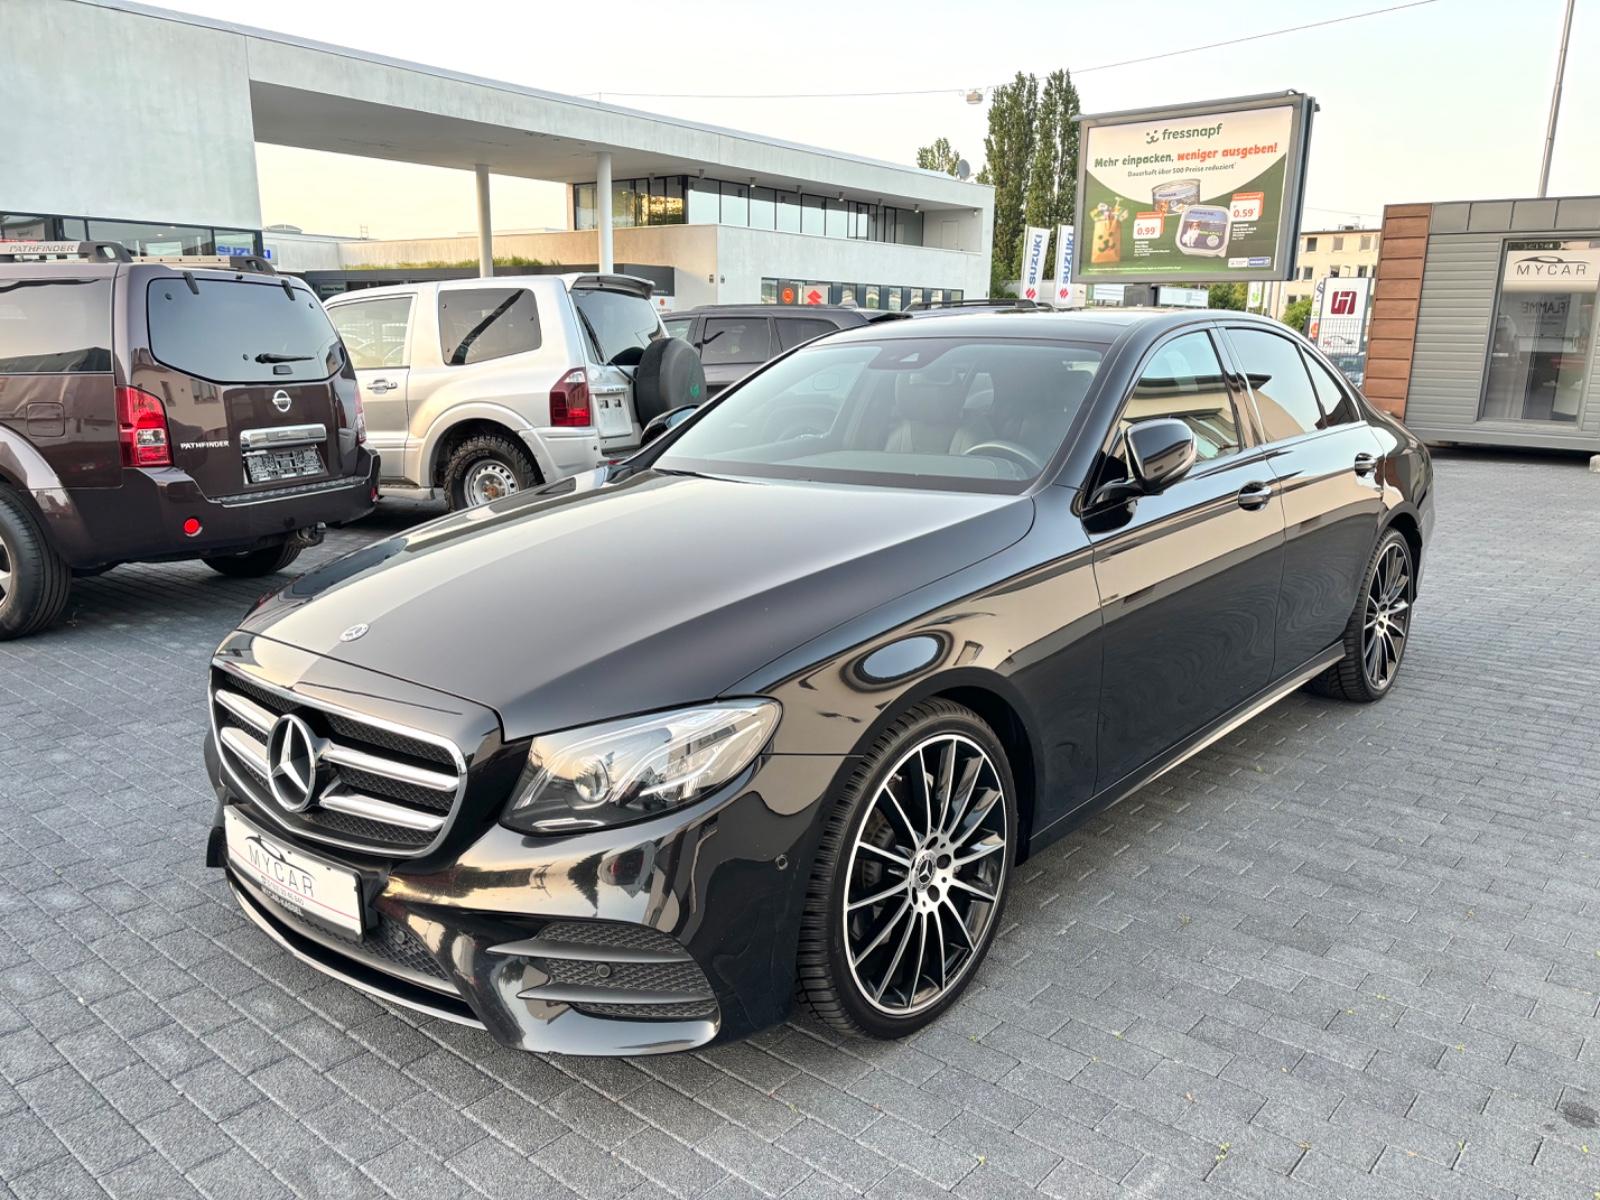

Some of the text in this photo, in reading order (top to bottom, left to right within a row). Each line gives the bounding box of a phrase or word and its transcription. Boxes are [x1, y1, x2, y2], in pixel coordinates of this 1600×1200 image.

[1162, 123, 1223, 140] fressnapf
[1094, 142, 1278, 168] Mehr einpacken, weniger ausgeben!
[1127, 168, 1158, 177] Dauerhaft
[1158, 167, 1171, 175] über
[1172, 166, 1184, 174] 500
[1185, 165, 1204, 173] Preise
[9, 244, 76, 253] PATHFINDER
[217, 245, 272, 260] SUZI
[1029, 234, 1043, 285] SUZUKI
[1063, 232, 1074, 285] SUZUKI
[1516, 264, 1587, 276] MYCAR
[180, 439, 230, 450] PATHFINDER
[248, 844, 315, 898] MYCAR
